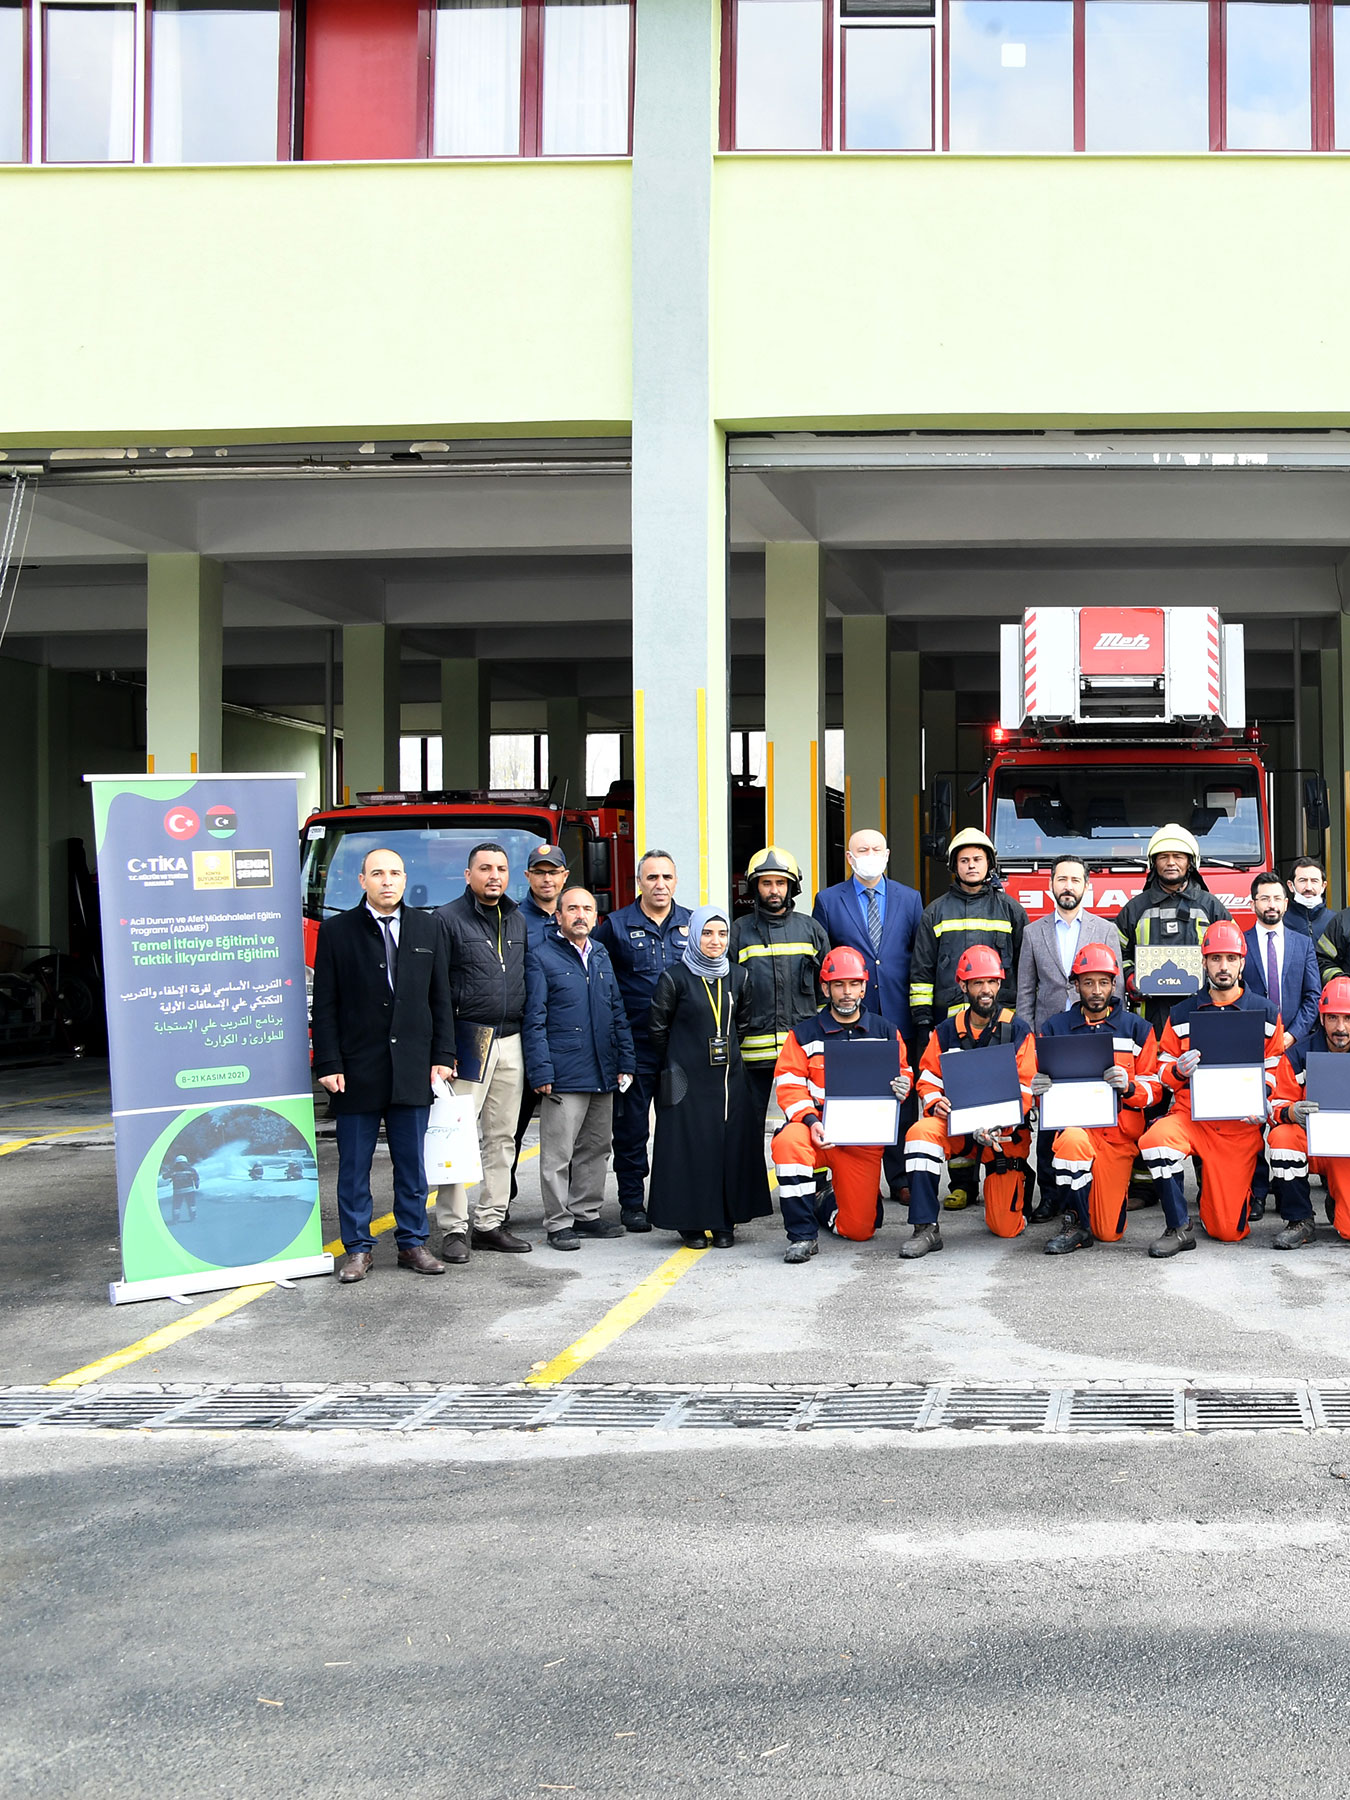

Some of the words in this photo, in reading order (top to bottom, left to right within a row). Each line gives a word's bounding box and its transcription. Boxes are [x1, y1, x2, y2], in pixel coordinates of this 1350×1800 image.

[1093, 632, 1150, 650] Metz
[147, 855, 188, 872] TİKA
[1214, 893, 1252, 908] Met
[130, 917, 145, 926] Acil
[146, 916, 175, 926] Durum
[175, 916, 186, 924] ve
[187, 914, 204, 923] Afet
[205, 912, 256, 923] Müdahaleleri
[257, 911, 281, 921] Eğitim
[130, 925, 169, 936] Programı
[170, 923, 209, 934] (ADAMEP)
[131, 939, 172, 952] Temel
[173, 936, 214, 951] İtfaiye
[215, 933, 258, 949] Eğitimi
[260, 934, 275, 945] ve
[132, 952, 173, 966] Taktik
[175, 950, 235, 966] İlkyardım
[237, 946, 279, 962] Eğitimi
[252, 978, 282, 992] التدريب
[1165, 977, 1182, 985] TİKA
[120, 987, 157, 1002] والتدريب
[190, 984, 211, 996] لفرقة
[213, 980, 250, 998] الأساسي
[159, 1000, 185, 1015] الأولية
[219, 1015, 252, 1030] التدريب
[255, 1014, 283, 1029] برنامج
[204, 1033, 238, 1049] الكوارث
[241, 1036, 247, 1046] و
[200, 1073, 226, 1082] KASIM
[227, 1071, 245, 1080] 2021
